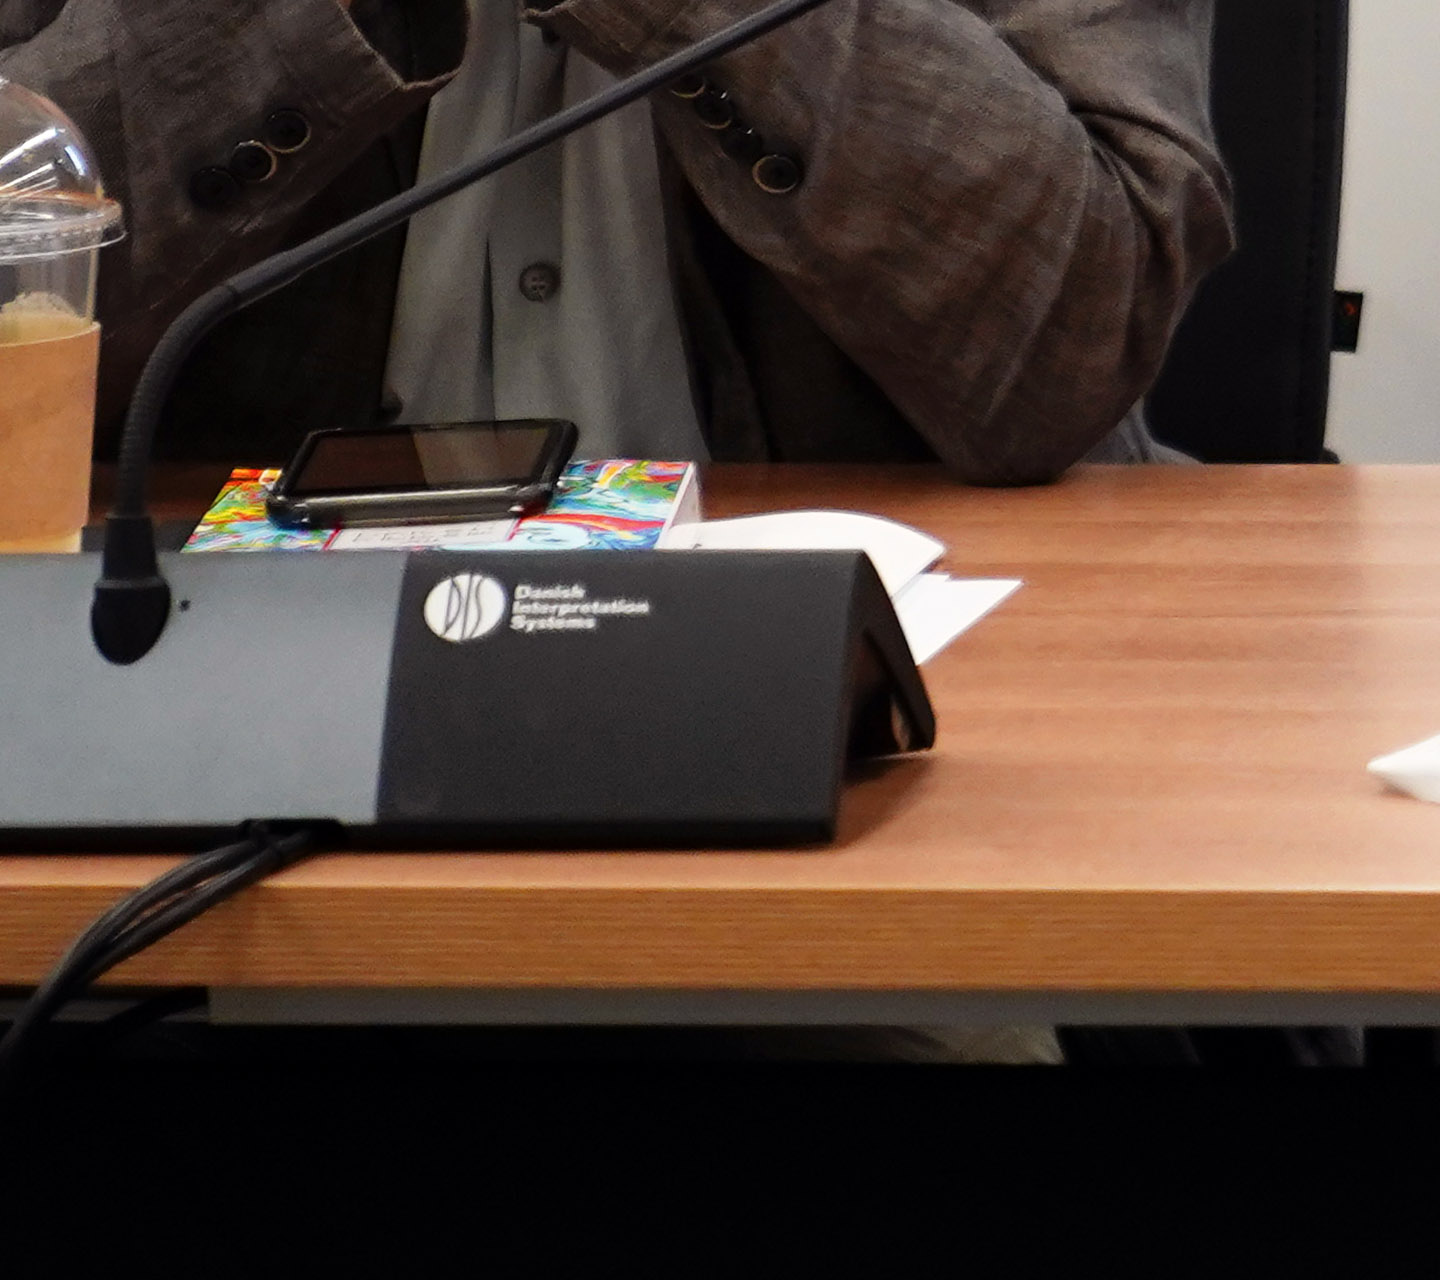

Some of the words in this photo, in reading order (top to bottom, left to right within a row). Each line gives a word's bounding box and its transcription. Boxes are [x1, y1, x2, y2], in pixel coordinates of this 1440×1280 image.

[513, 584, 586, 600] Danish
[512, 600, 649, 617] Interpretation
[510, 614, 597, 632] Systems
